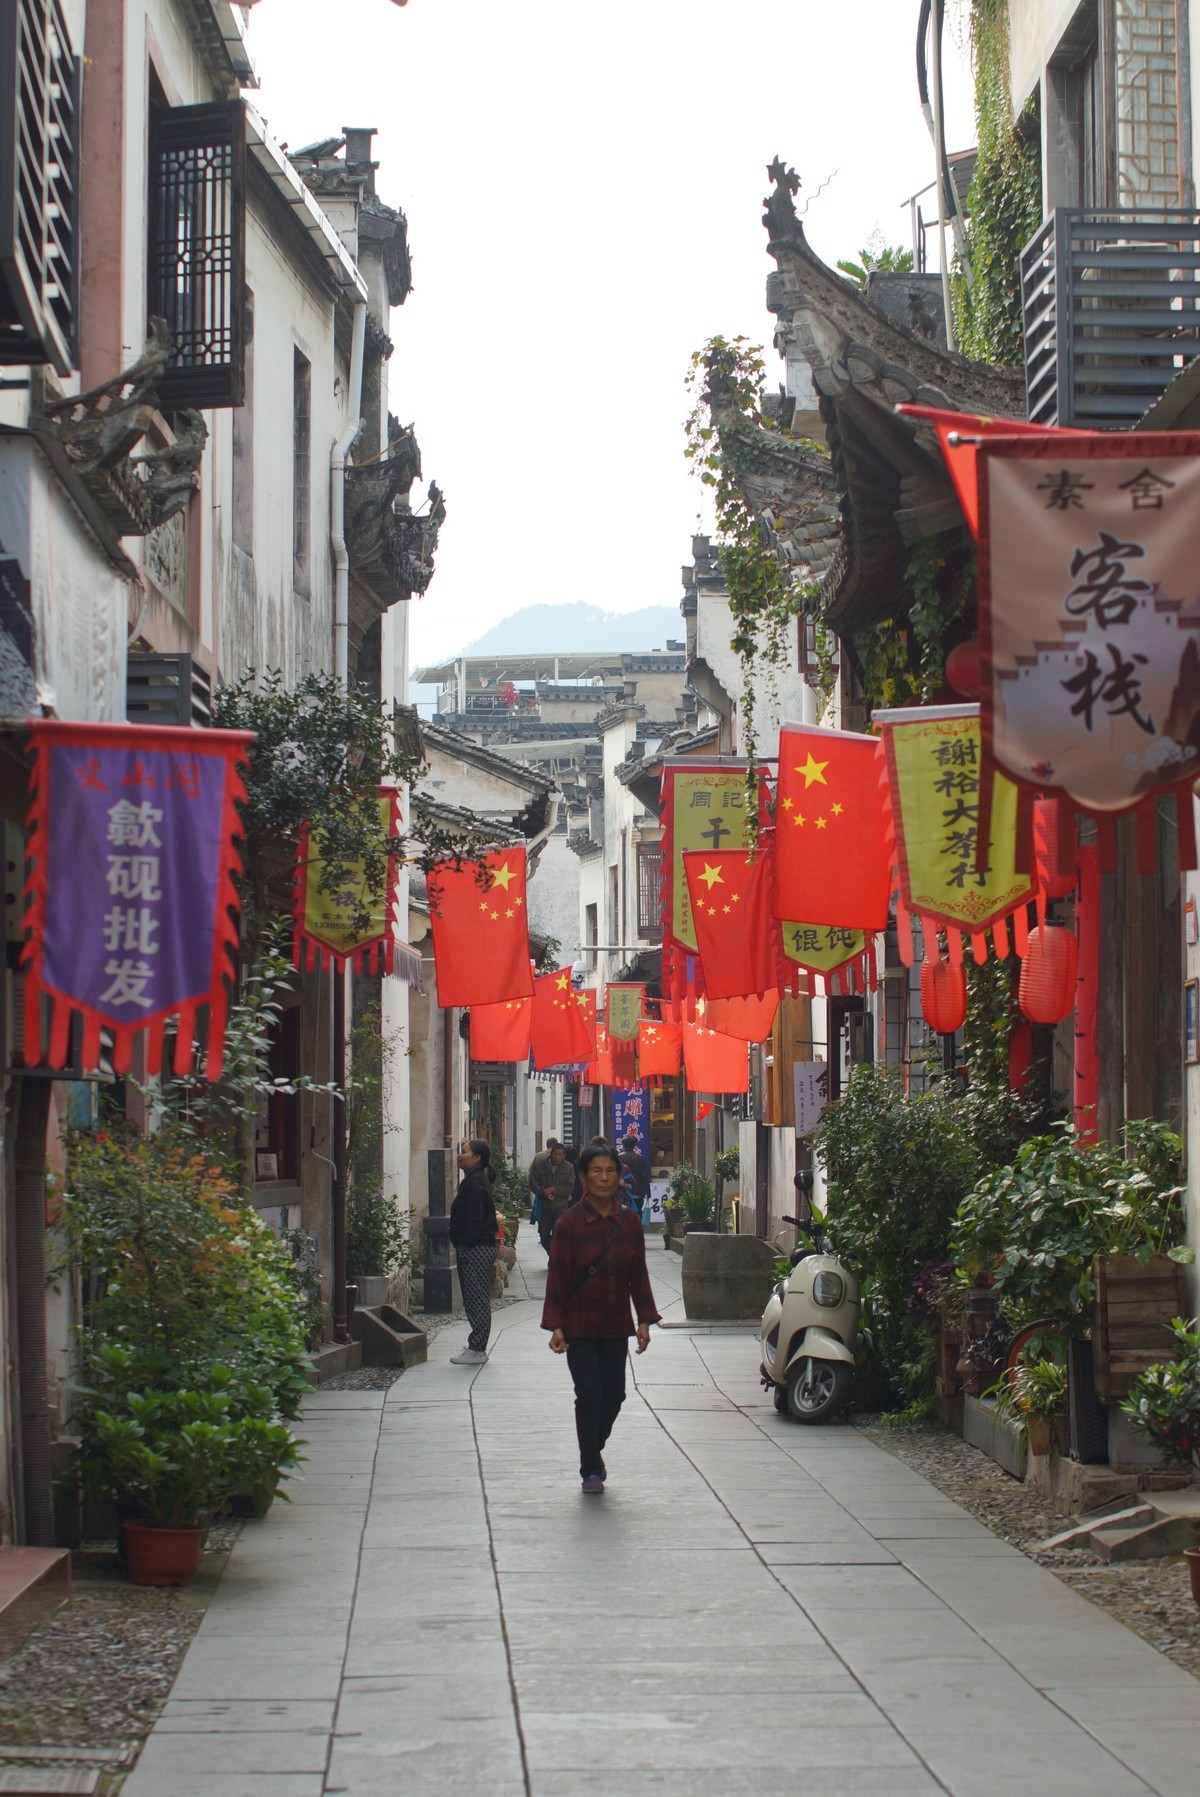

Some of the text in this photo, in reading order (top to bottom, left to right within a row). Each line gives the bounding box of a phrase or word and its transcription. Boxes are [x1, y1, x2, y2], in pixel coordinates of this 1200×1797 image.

[1036, 467, 1175, 511] 素舍
[1059, 531, 1156, 735] 客栈
[931, 738, 994, 888] 謝裕大茶行
[100, 798, 163, 1008] 歙砚批发
[791, 926, 856, 952] 馄饨
